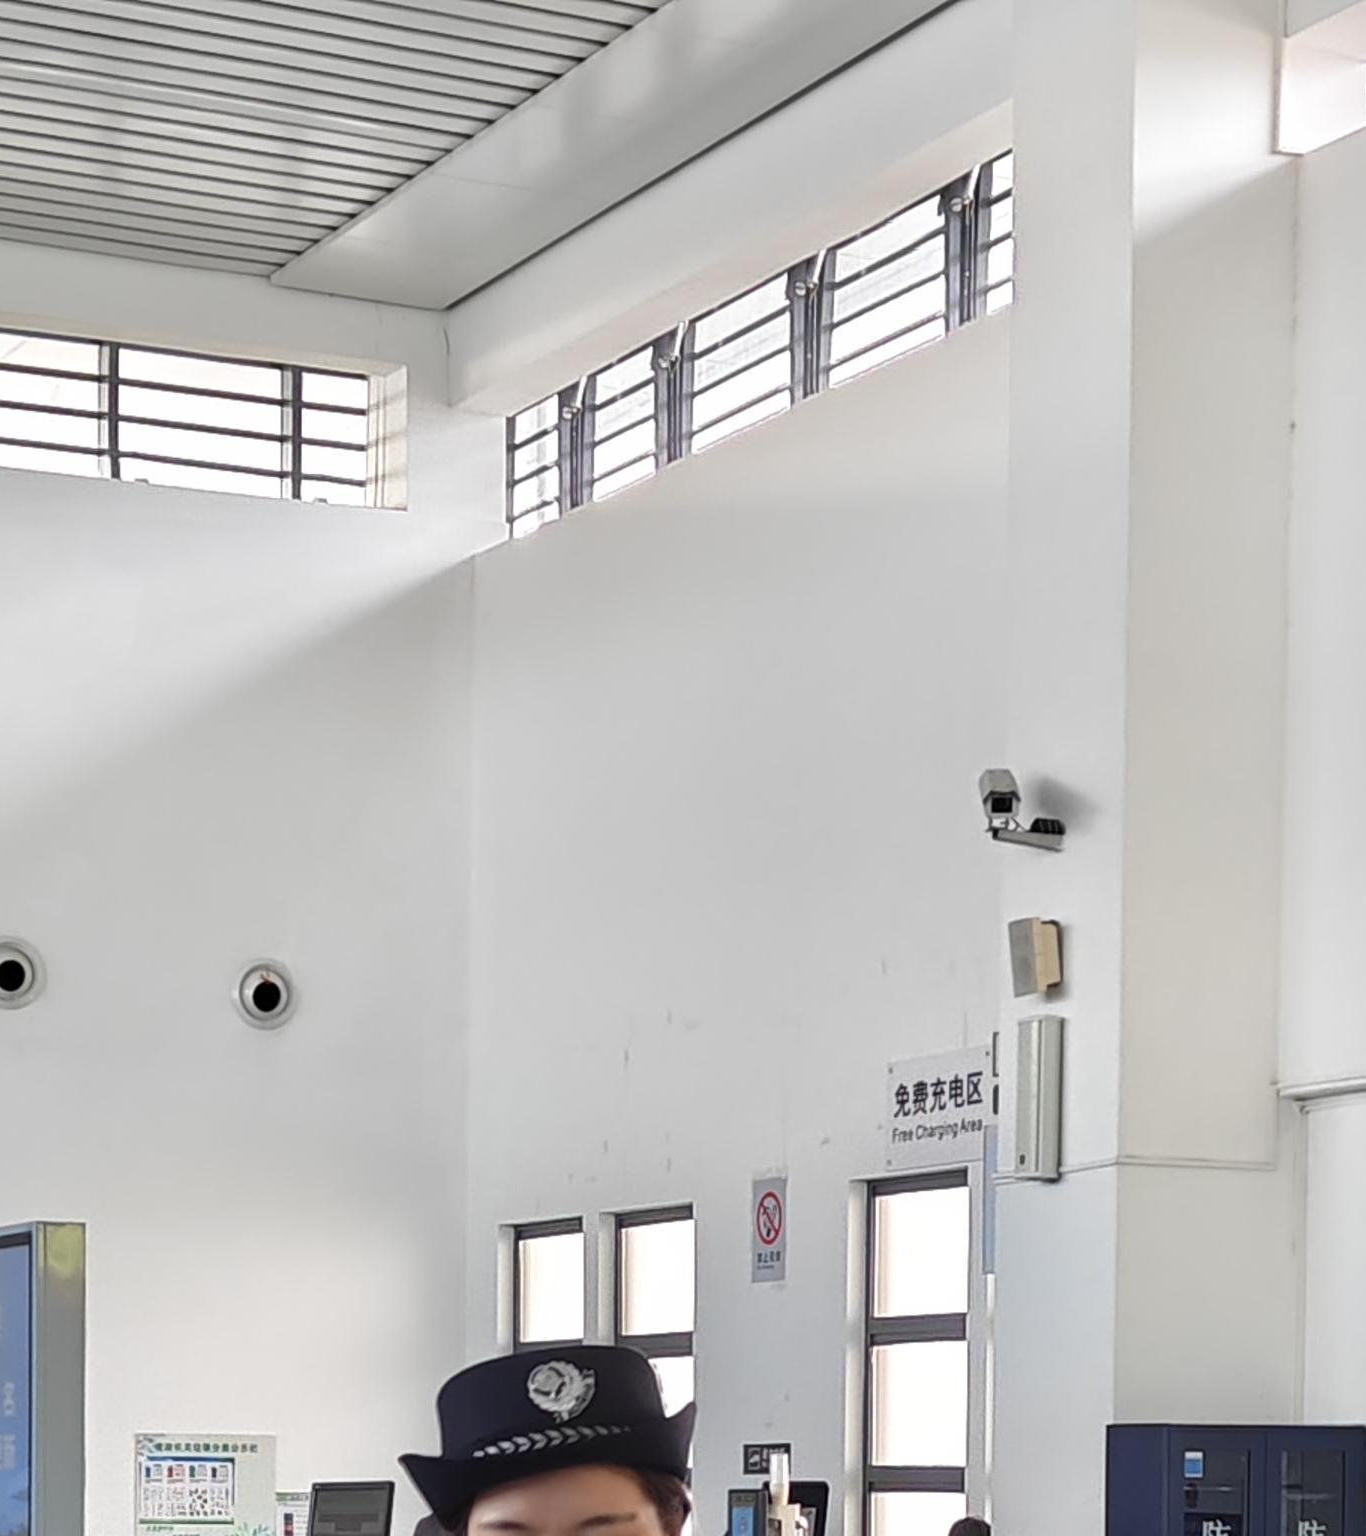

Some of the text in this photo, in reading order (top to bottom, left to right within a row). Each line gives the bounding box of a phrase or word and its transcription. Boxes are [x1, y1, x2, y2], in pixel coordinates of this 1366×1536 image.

[894, 1070, 983, 1118] 免费充电区
[892, 1128, 913, 1143] Free
